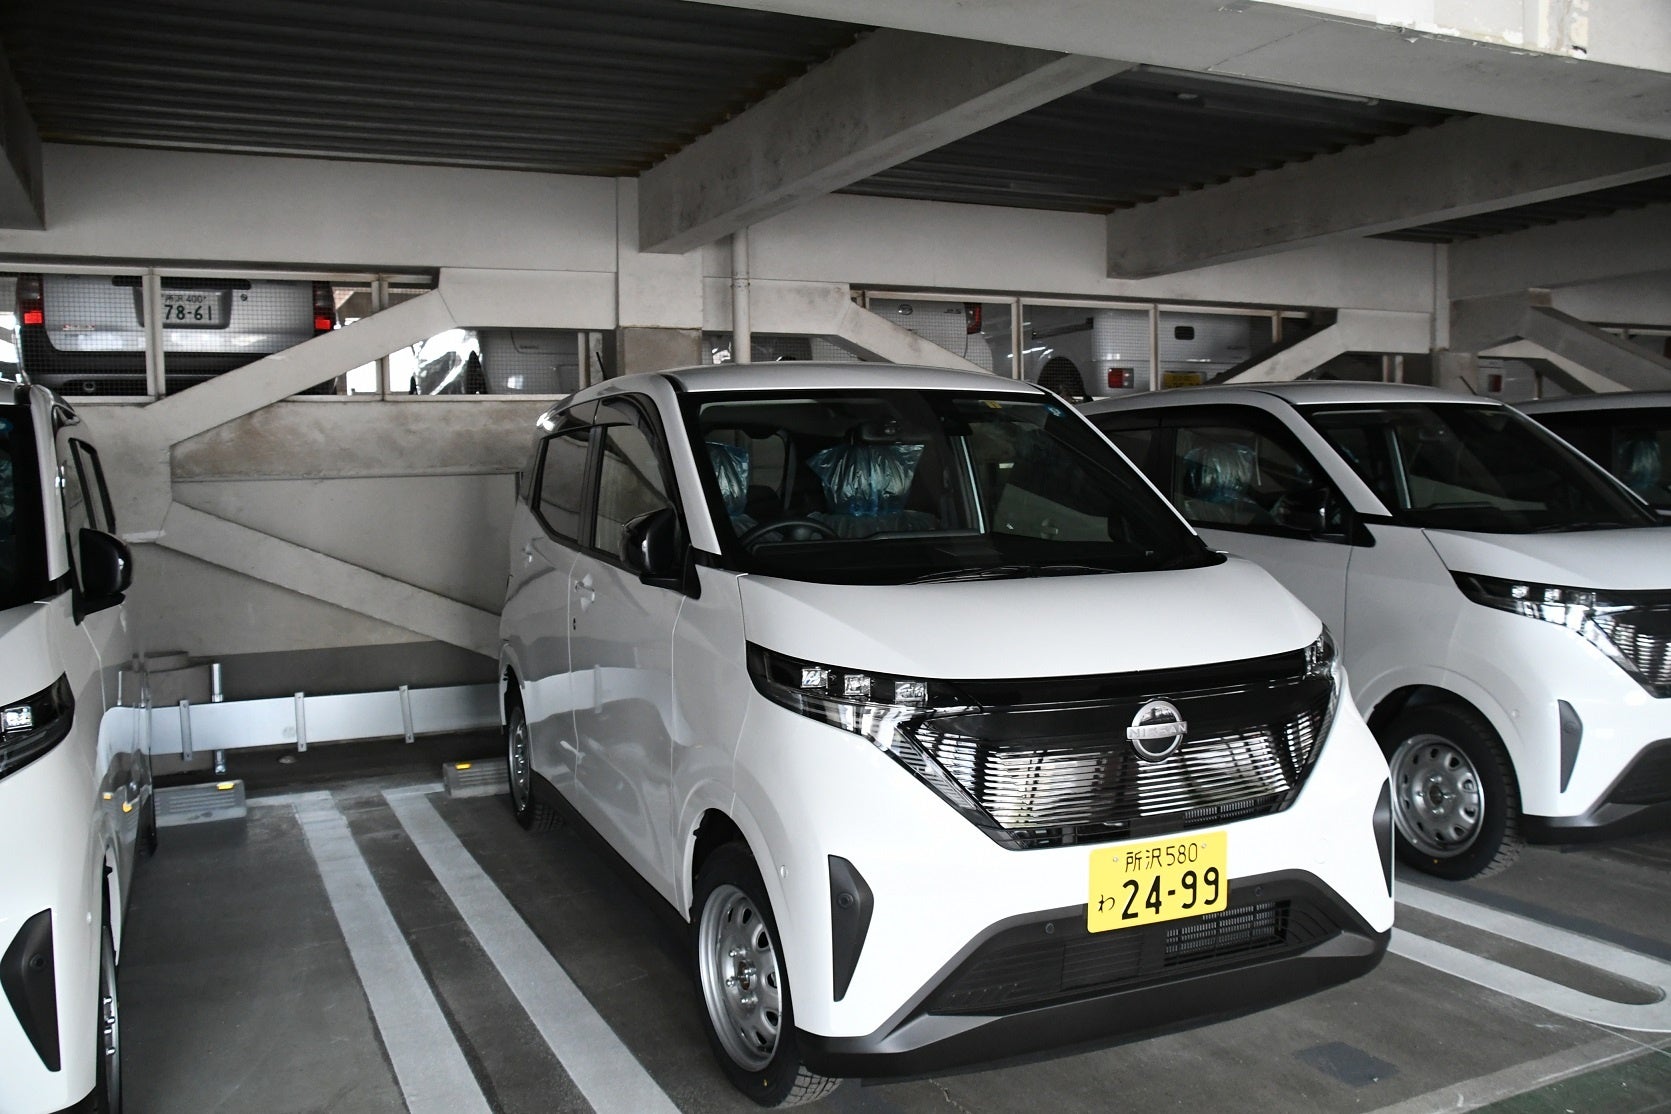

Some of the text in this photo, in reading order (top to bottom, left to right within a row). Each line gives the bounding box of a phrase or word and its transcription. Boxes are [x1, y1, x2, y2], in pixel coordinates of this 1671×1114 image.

[164, 305, 212, 320] 78-61
[1098, 867, 1219, 920] わ 24-99
